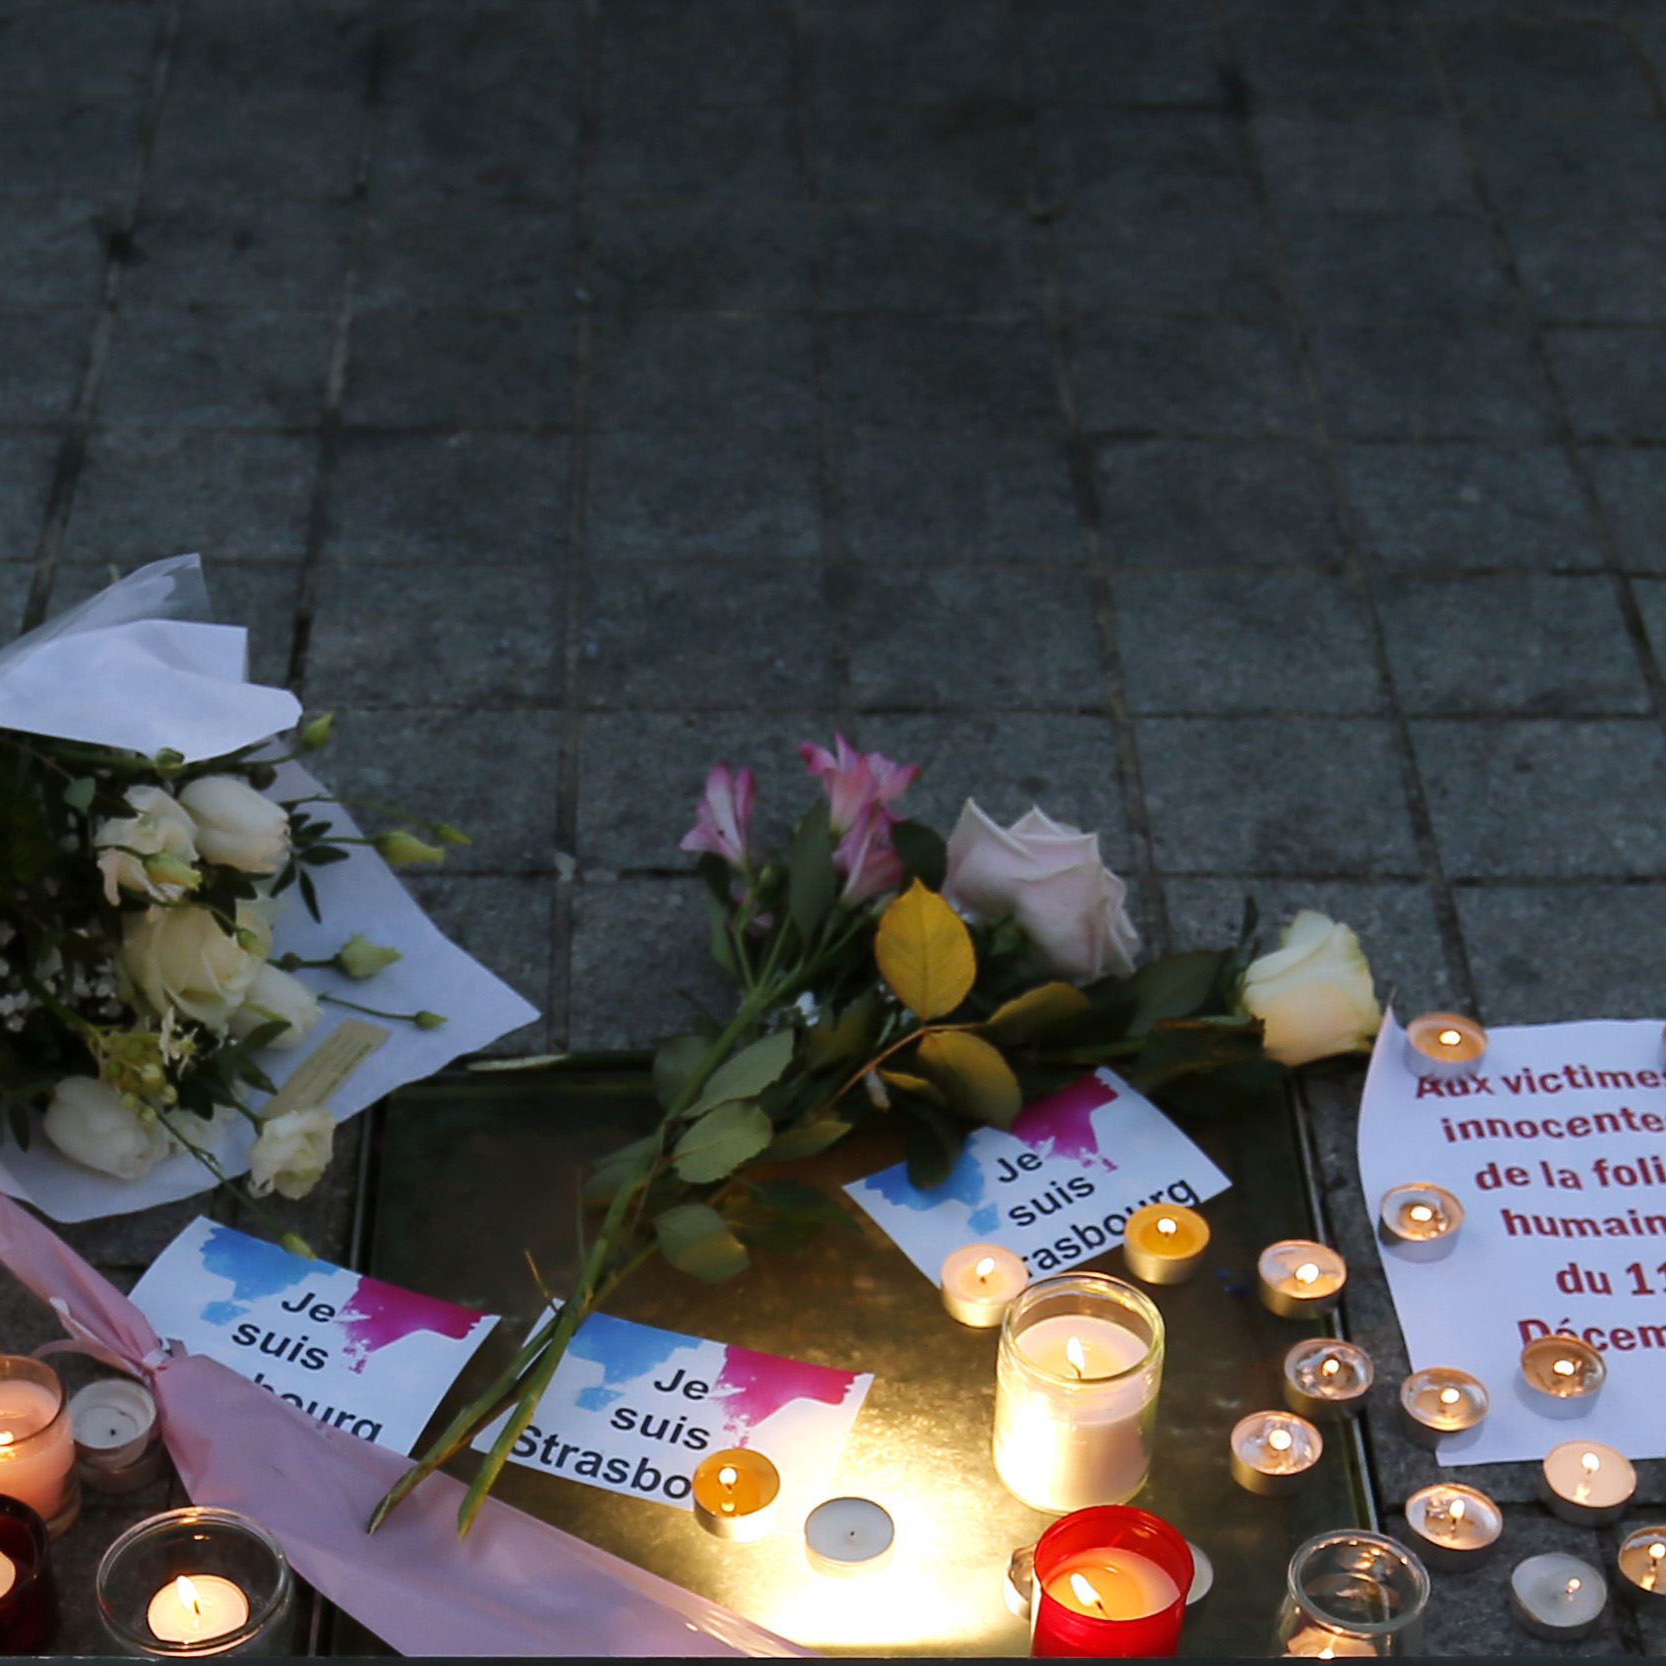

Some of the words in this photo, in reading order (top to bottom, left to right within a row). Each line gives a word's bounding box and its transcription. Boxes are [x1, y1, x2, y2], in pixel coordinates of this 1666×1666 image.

[1416, 1072, 1494, 1098] Aux
[997, 1152, 1043, 1183] Je
[1475, 1162, 1530, 1190] de
[1539, 1161, 1583, 1190] la
[1008, 1176, 1095, 1227] suis
[1556, 1262, 1612, 1295] du
[281, 1292, 335, 1322] Je
[231, 1323, 328, 1370] suis
[654, 1369, 709, 1401] Je
[610, 1407, 710, 1450] suis
